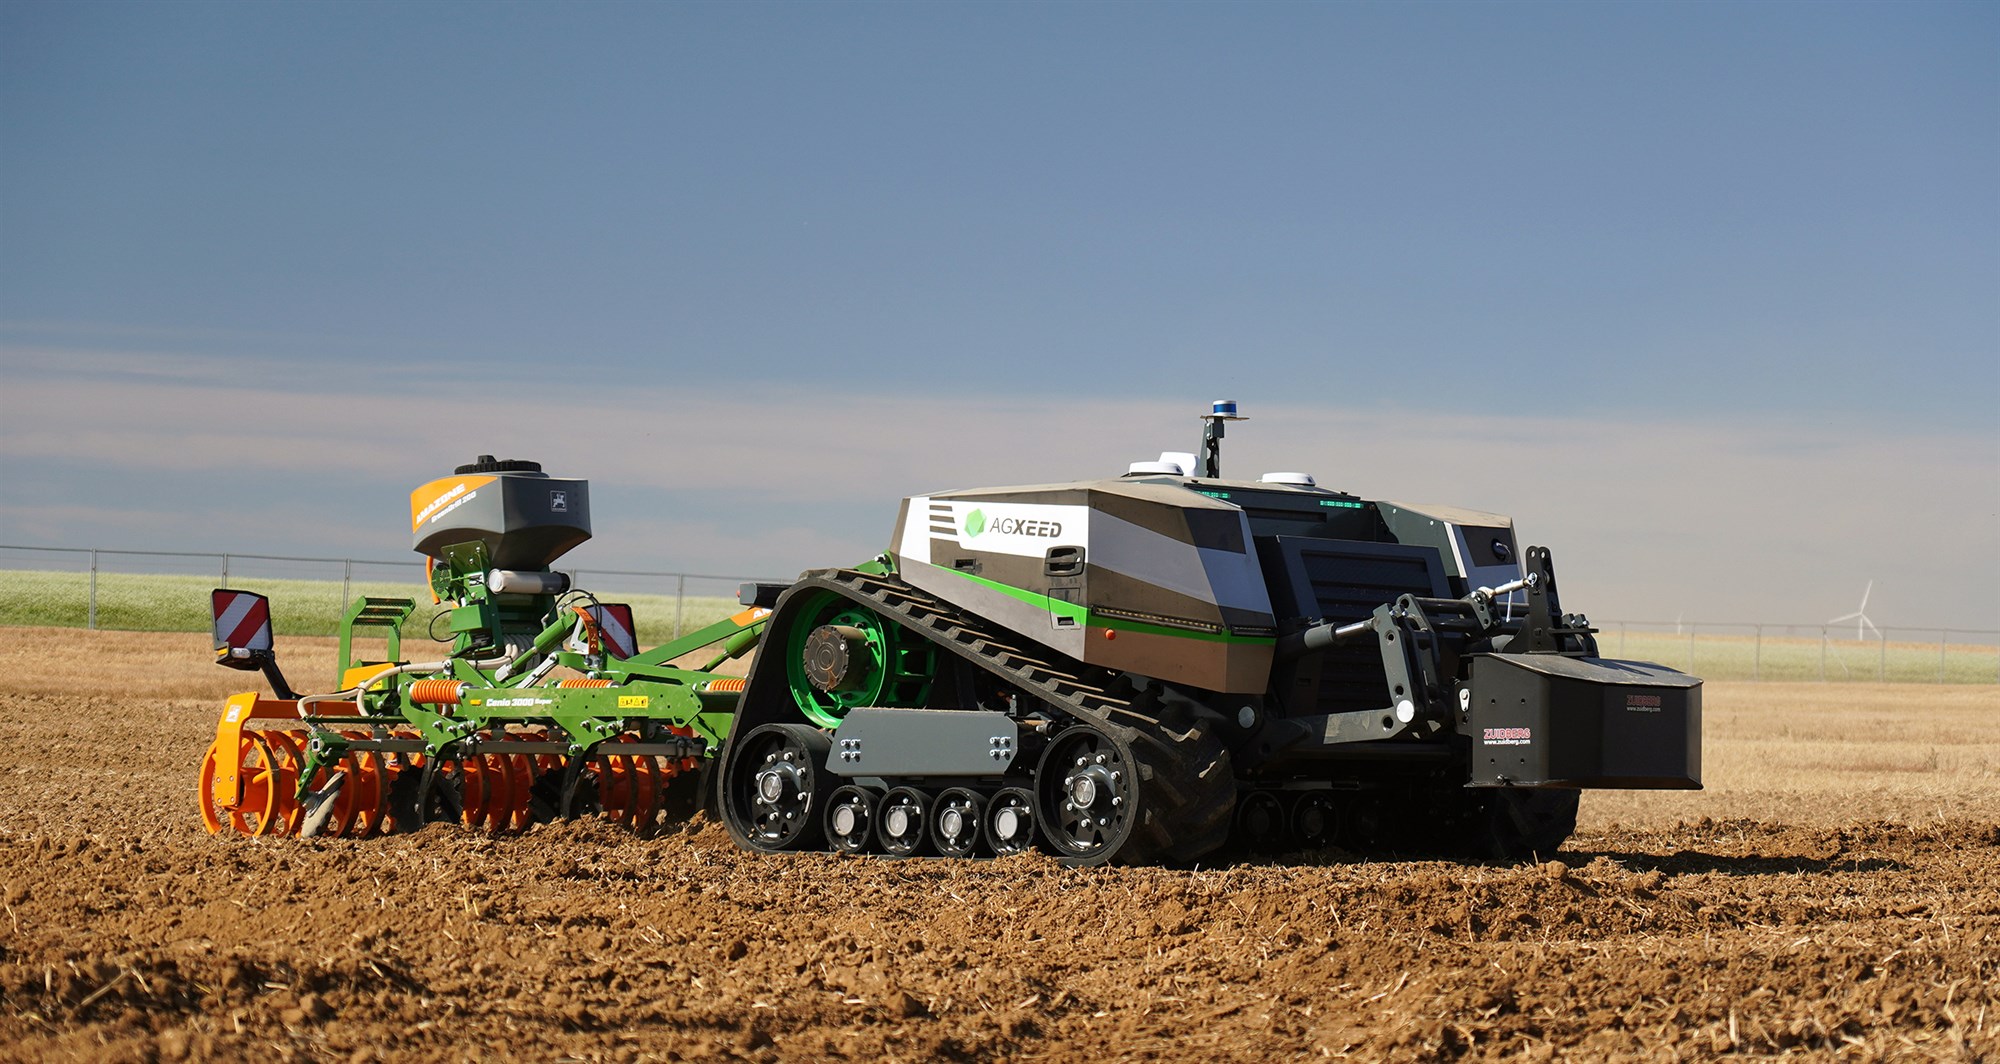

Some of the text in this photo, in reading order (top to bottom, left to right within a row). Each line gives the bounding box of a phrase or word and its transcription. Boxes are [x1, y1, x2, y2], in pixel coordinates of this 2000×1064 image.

[416, 483, 465, 525] AMAZONE
[989, 517, 1062, 538] AGXEED
[486, 698, 511, 707] Cenio
[511, 698, 535, 707] 3000
[1626, 695, 1661, 707] ZUIDBERG
[1483, 728, 1531, 740] ZUIDBERG
